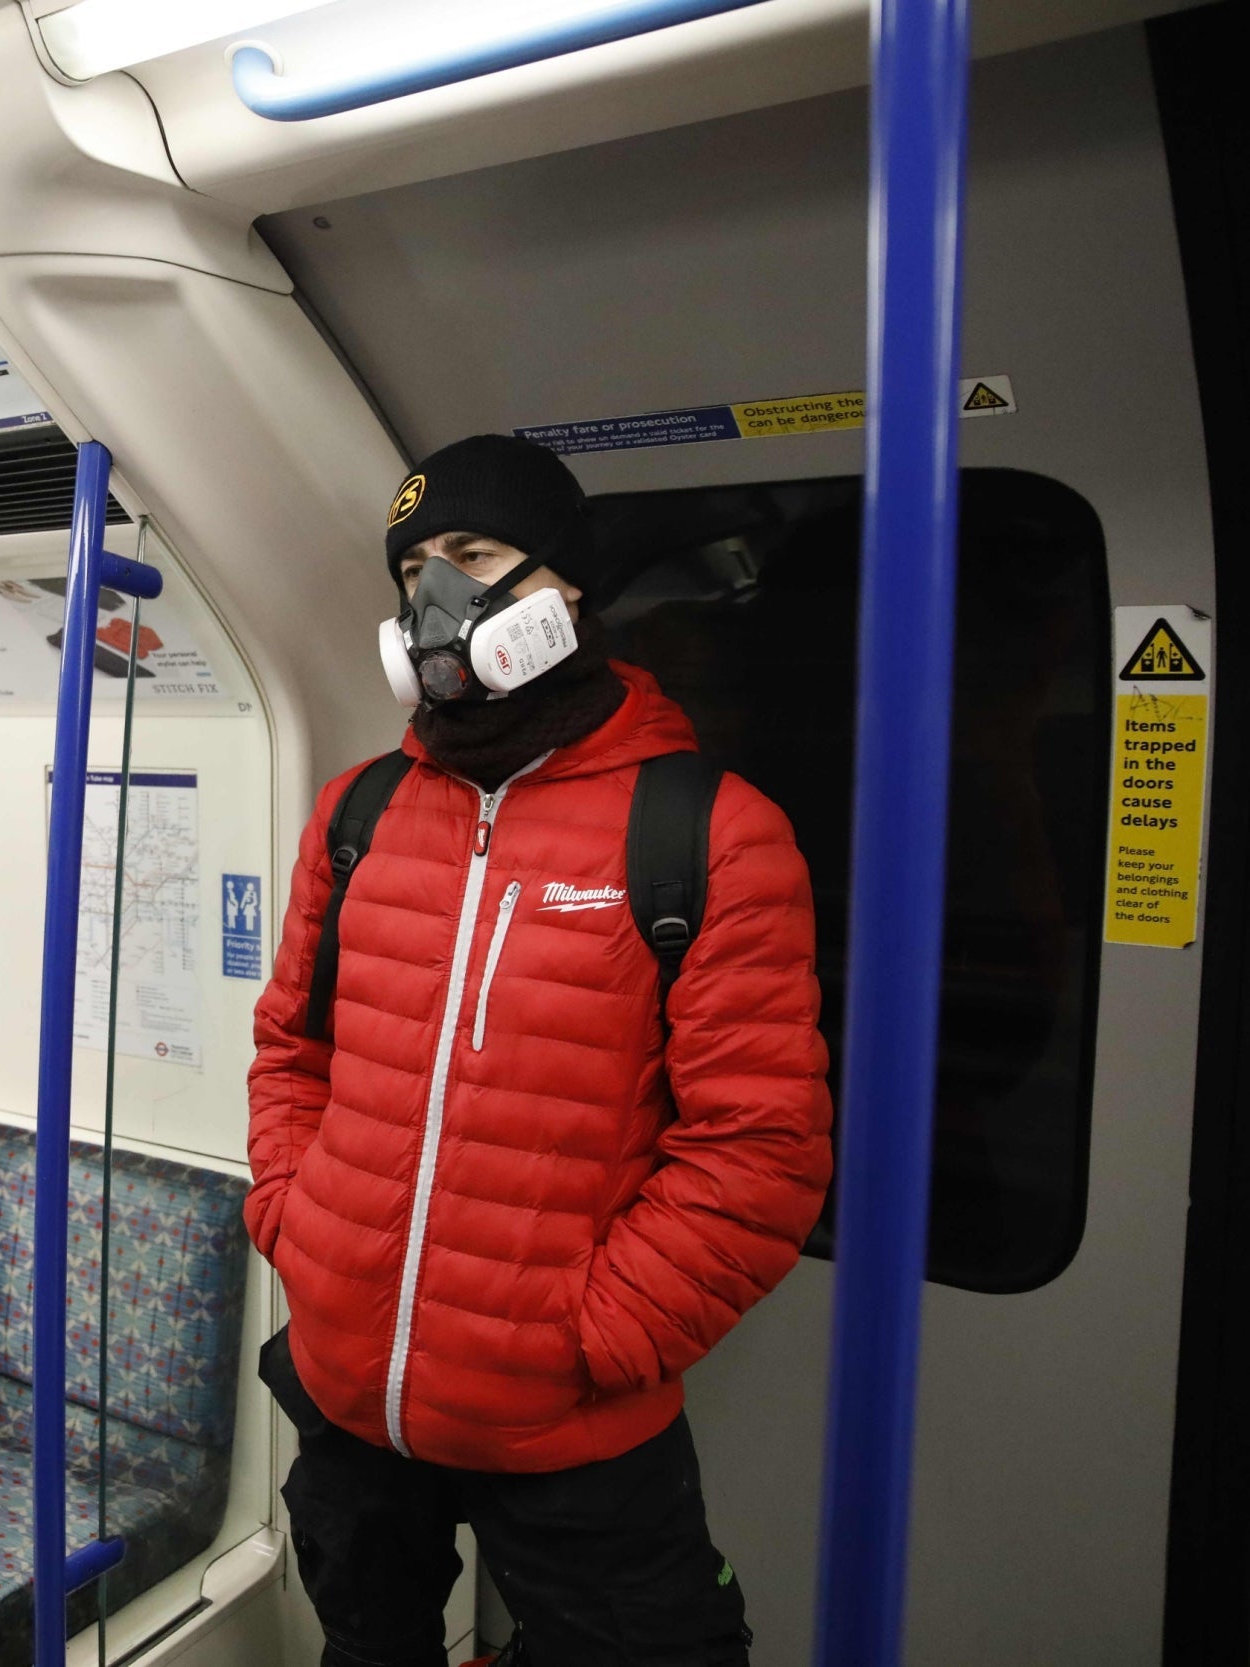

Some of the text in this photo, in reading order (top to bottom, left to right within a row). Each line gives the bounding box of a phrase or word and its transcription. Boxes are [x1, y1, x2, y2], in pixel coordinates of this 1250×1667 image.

[743, 398, 863, 417] Obstructing the
[21, 414, 40, 424] Zone
[748, 419, 773, 428] can
[777, 416, 796, 426] be
[524, 427, 570, 440] Penalty
[572, 424, 599, 435] fare
[601, 422, 615, 432] or
[618, 414, 697, 431] prosecution
[669, 432, 697, 442] Oyster
[497, 650, 511, 670] JSP
[152, 683, 219, 694] STITCH FIX
[1125, 719, 1176, 732] Items
[1124, 739, 1196, 754] trapped
[1123, 757, 1176, 771] in the
[1122, 776, 1174, 790] doors
[1121, 797, 1172, 809] cause
[1120, 813, 1178, 830] delays
[1118, 846, 1155, 856] Please
[1118, 859, 1175, 871] keep your
[1117, 872, 1179, 886] belongings
[541, 881, 626, 904] Milwaukee
[1116, 886, 1188, 900] and clothing
[1116, 899, 1160, 909] clear of
[1115, 911, 1171, 924] the doors
